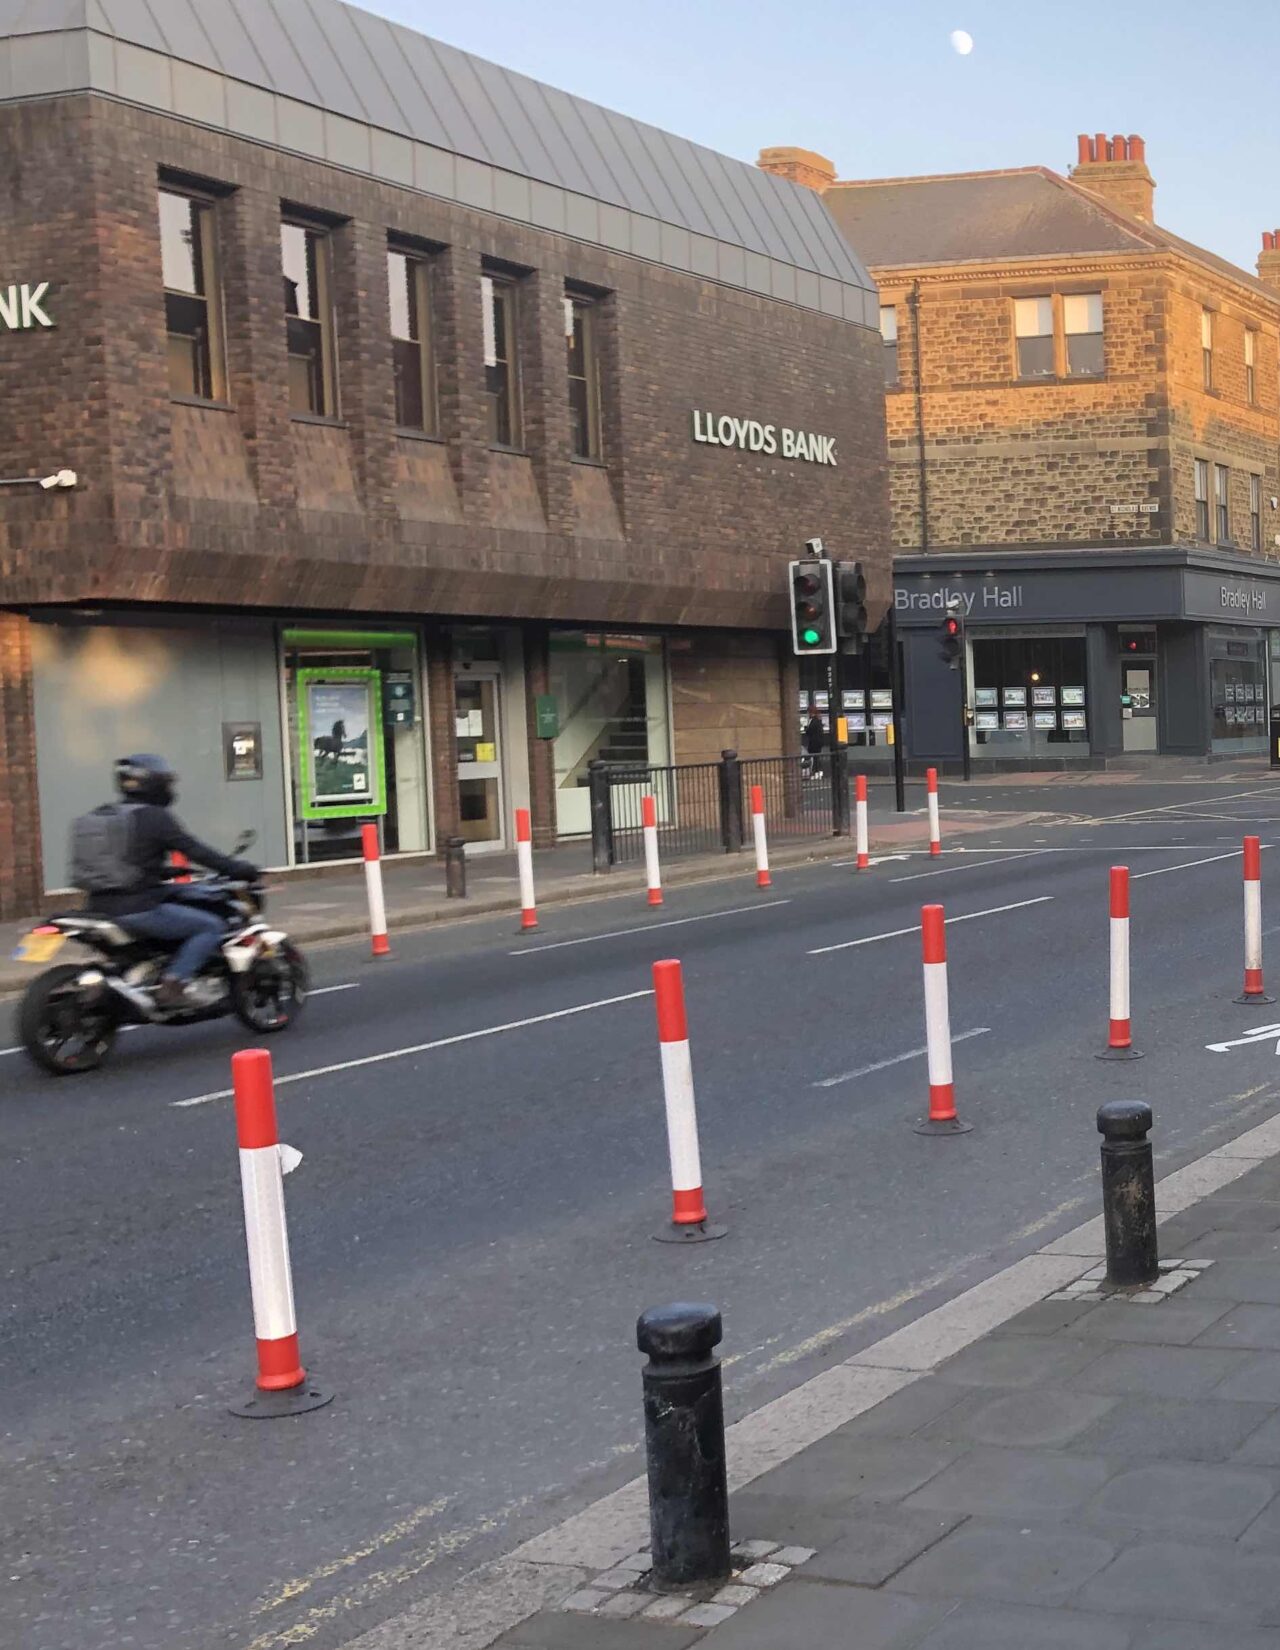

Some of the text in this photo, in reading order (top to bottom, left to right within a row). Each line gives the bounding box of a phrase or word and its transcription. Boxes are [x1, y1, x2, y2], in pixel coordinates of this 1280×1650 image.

[694, 410, 837, 466] LLOYDS BANK
[894, 586, 1022, 615] Bradley Hall
[1221, 586, 1266, 616] Bradley Hall
